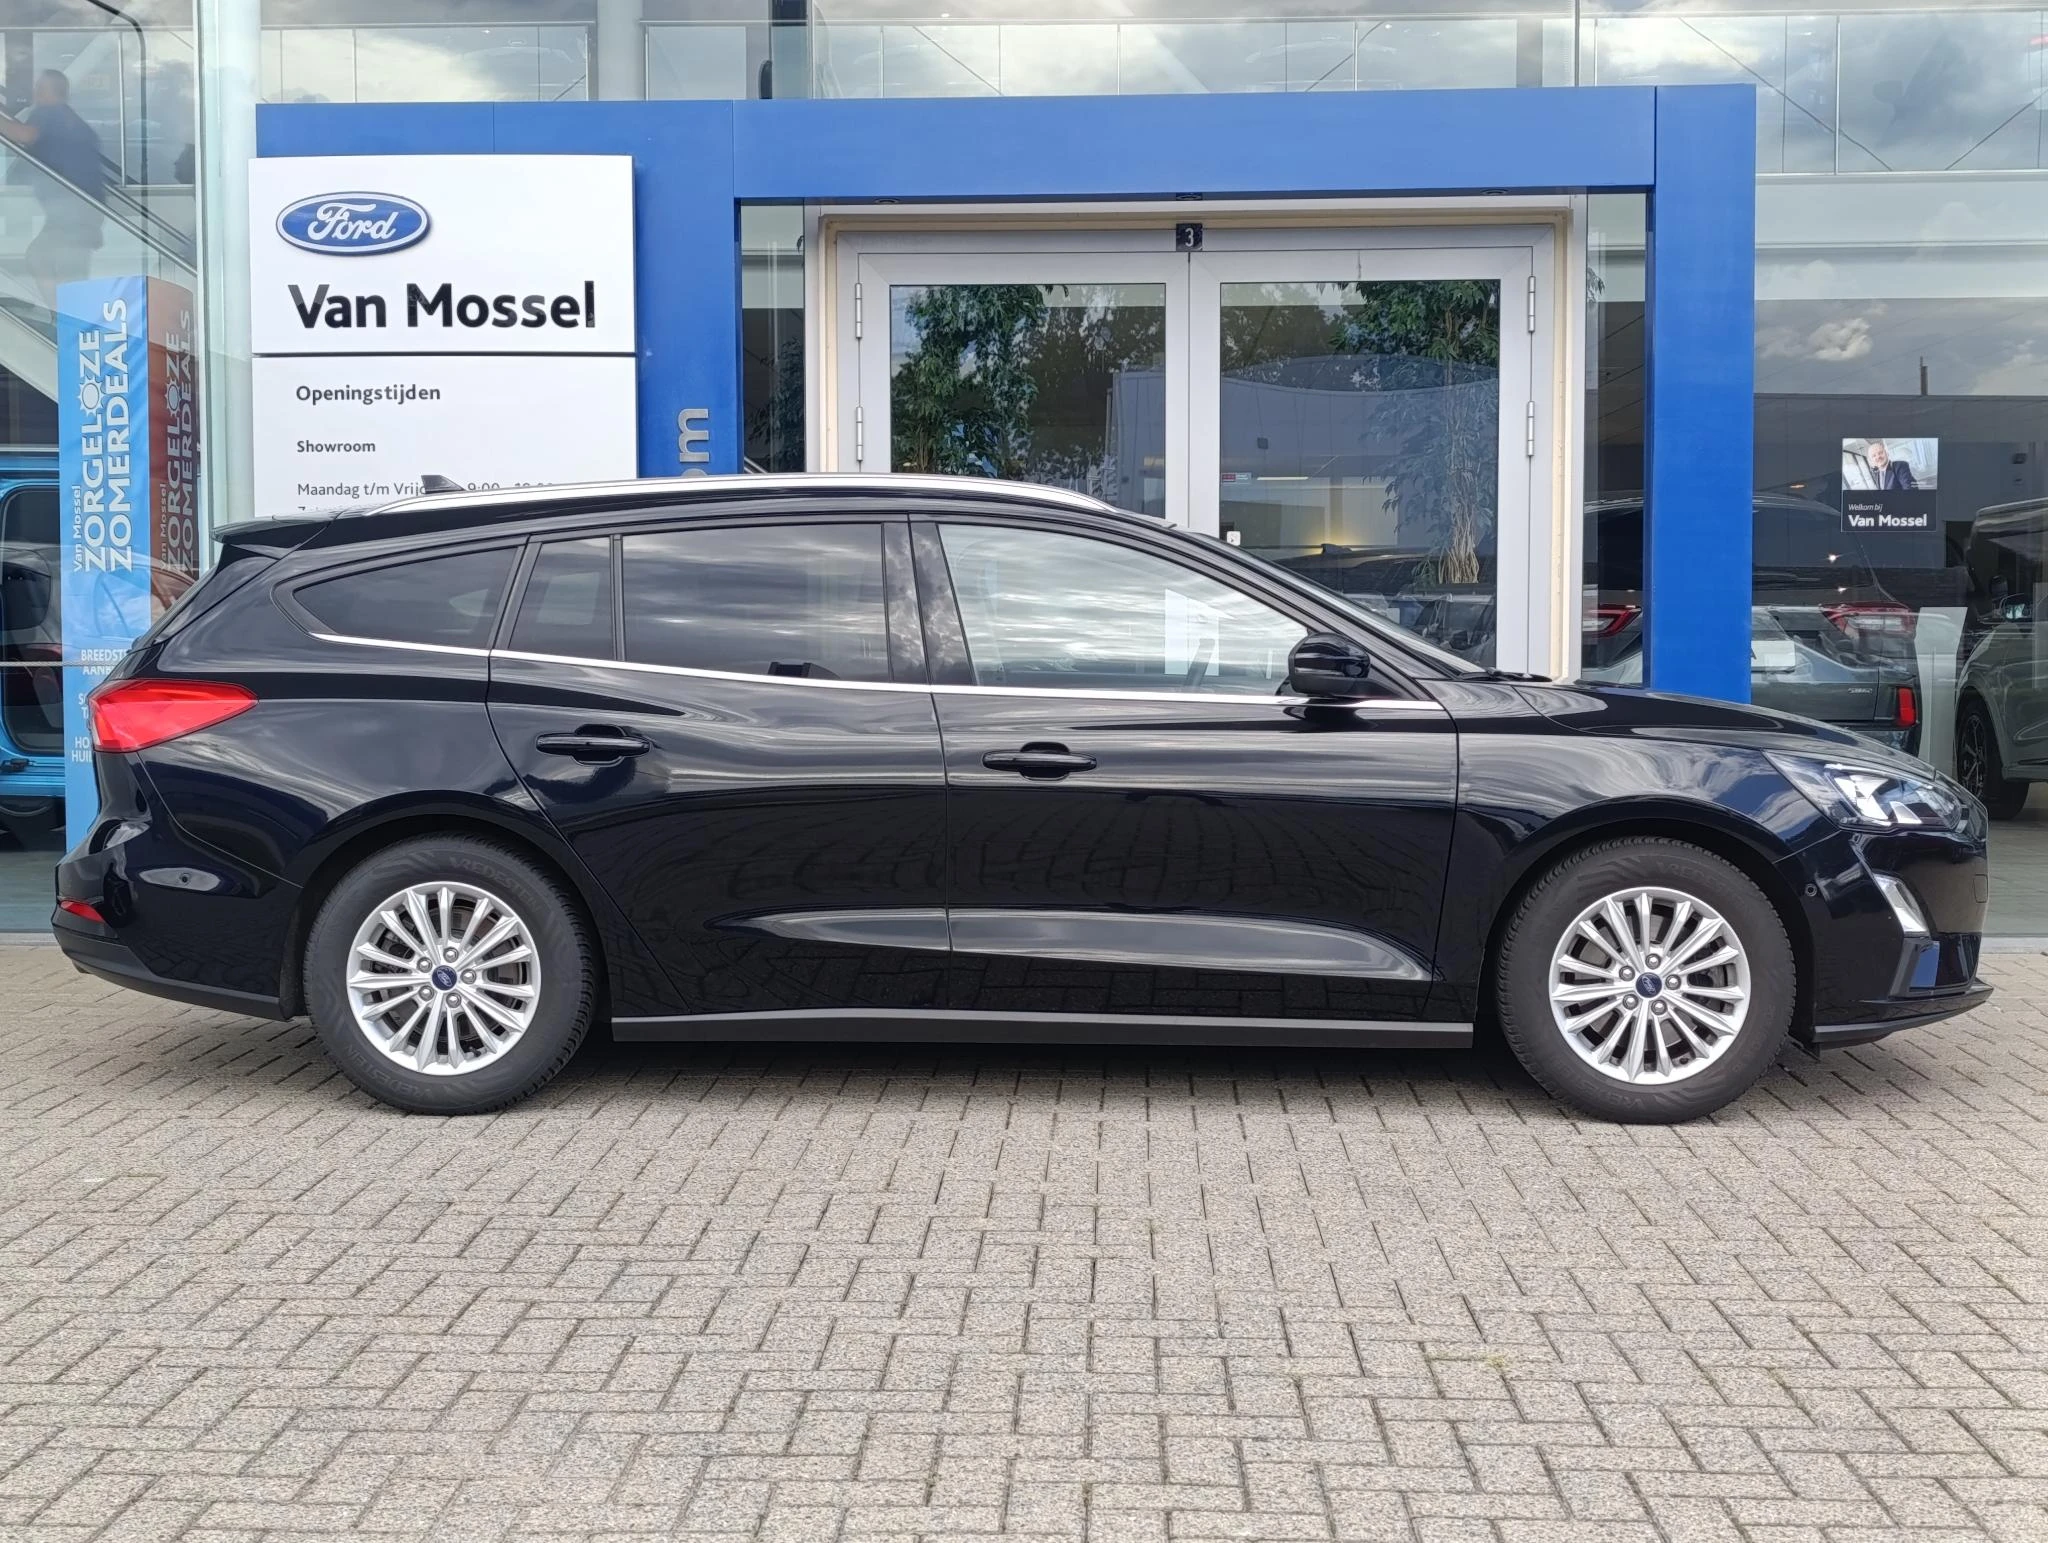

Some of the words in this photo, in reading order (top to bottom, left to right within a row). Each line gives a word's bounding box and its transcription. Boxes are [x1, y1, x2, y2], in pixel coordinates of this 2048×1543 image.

[307, 202, 399, 240] Ford
[1185, 228, 1194, 247] 3
[288, 284, 386, 328] Van
[406, 280, 595, 328] Mossel
[296, 384, 441, 406] Openingstijden
[103, 299, 132, 573] ZOMERDEALS
[297, 440, 376, 453] Showroom
[297, 482, 360, 499] Maandag
[364, 482, 390, 496] t/m
[72, 485, 83, 538] Mossel
[1874, 504, 1883, 513] bij
[1848, 515, 1875, 527] Van
[1878, 513, 1928, 527] Mossel
[73, 543, 83, 572] Van
